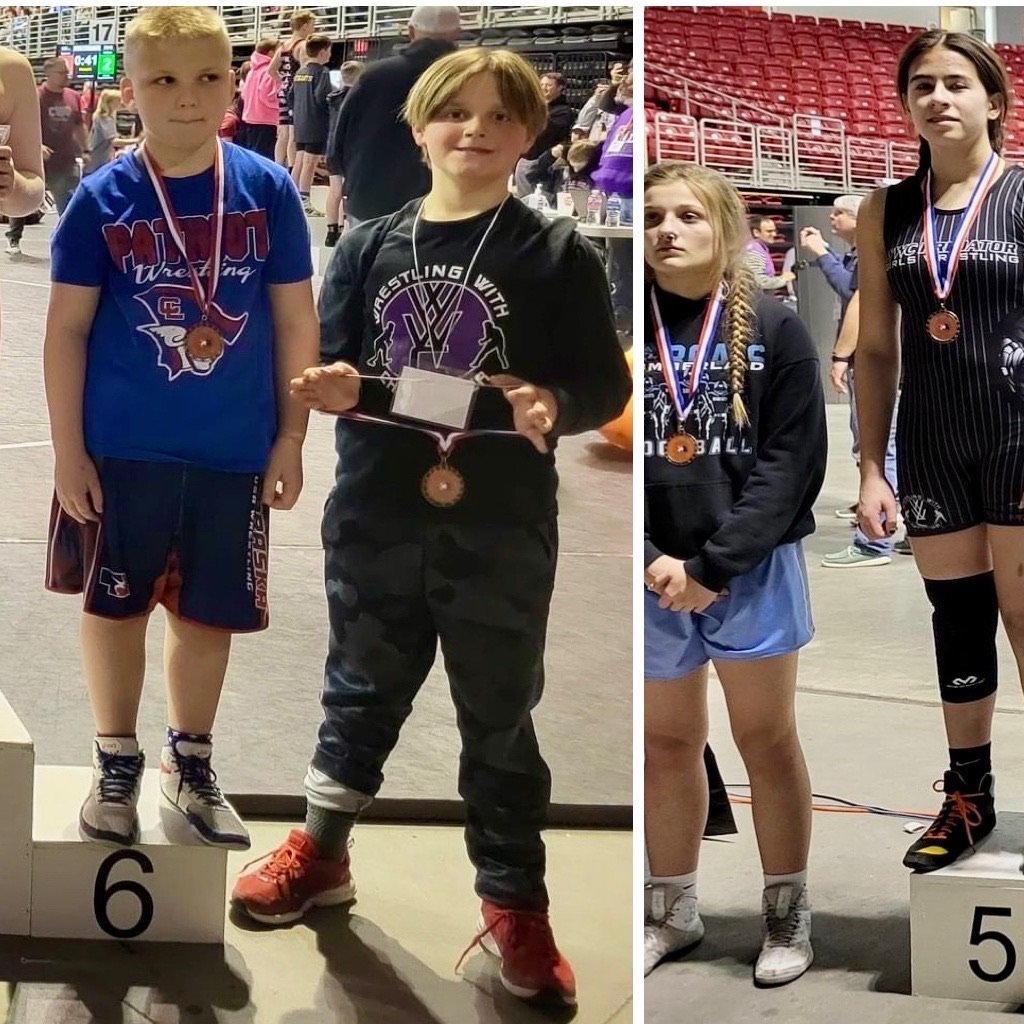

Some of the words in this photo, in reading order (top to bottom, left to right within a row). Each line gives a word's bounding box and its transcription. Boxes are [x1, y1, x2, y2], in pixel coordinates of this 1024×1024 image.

[92, 24, 113, 42] 17
[474, 274, 510, 318] WITH
[93, 848, 154, 939] 6
[968, 906, 1017, 982] 5
